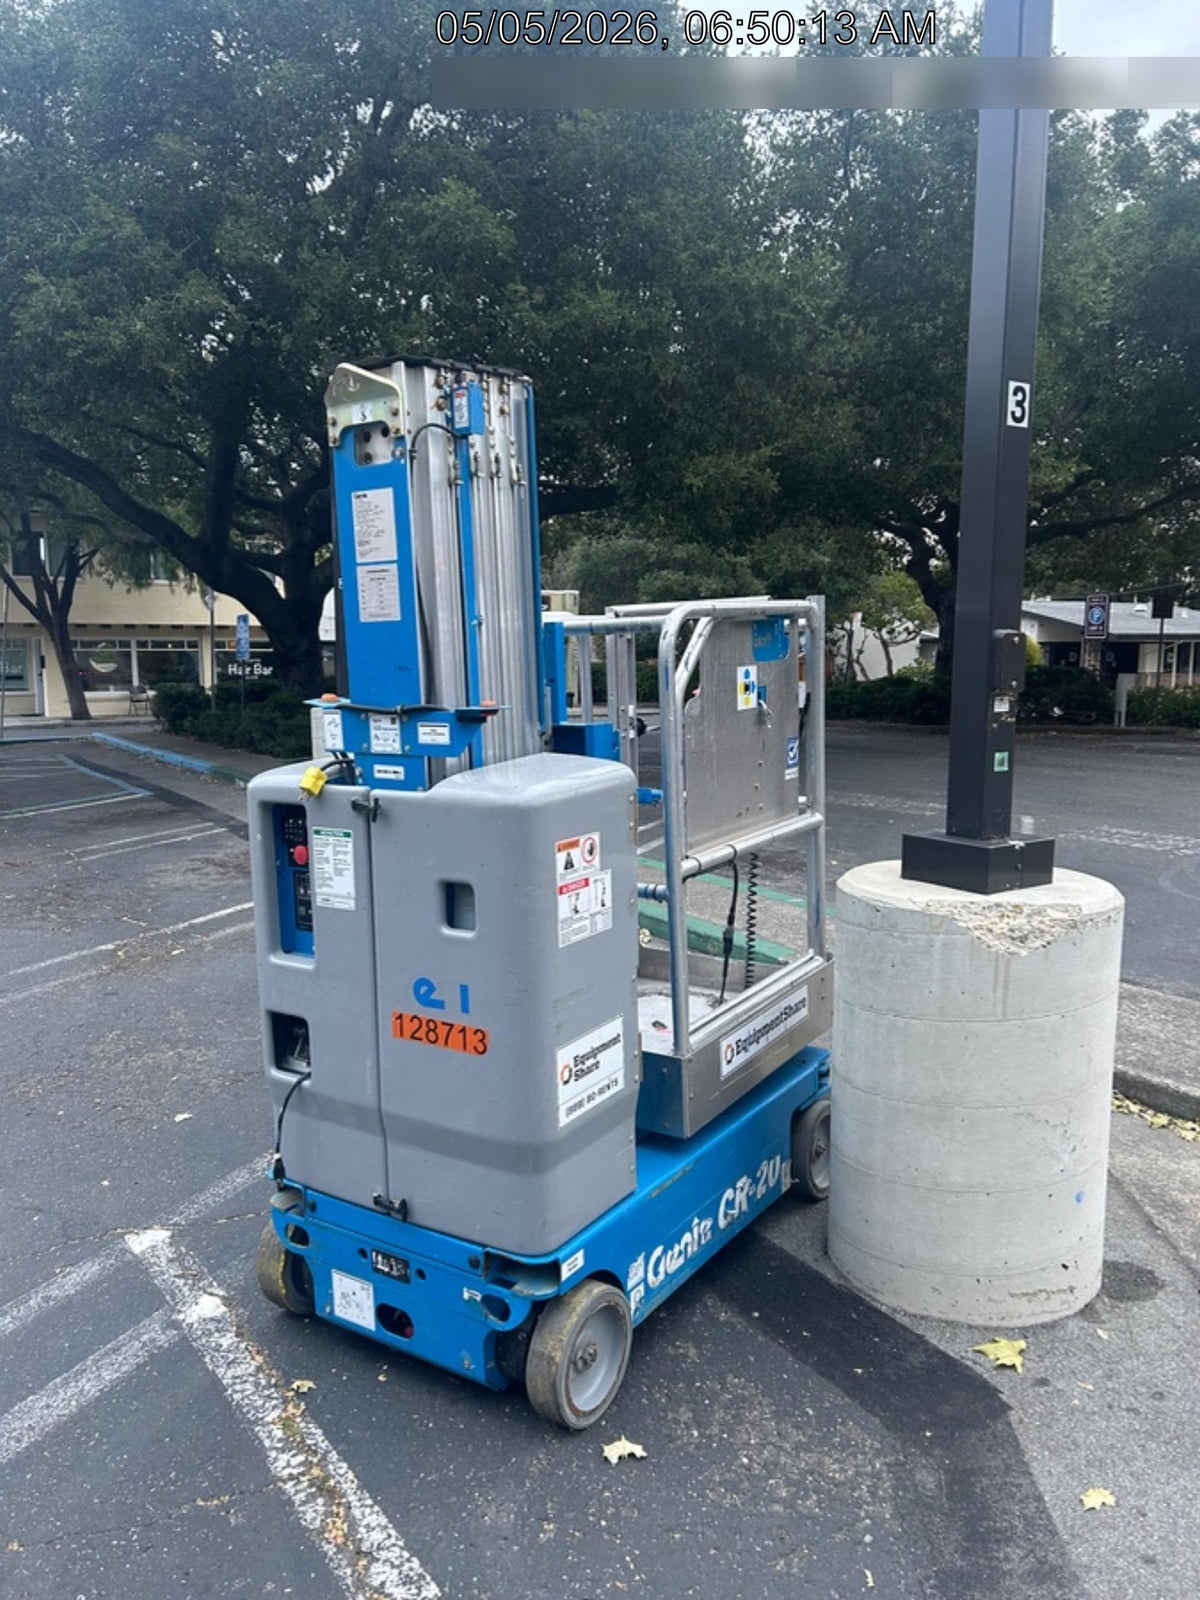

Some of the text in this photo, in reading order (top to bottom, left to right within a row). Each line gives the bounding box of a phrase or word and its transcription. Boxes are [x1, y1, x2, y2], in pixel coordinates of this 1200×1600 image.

[1011, 385, 1027, 424] 3
[253, 663, 273, 676] Bar
[394, 1012, 487, 1055] 128713
[735, 996, 807, 1056] EquipmentShare
[573, 1033, 621, 1068] Equipment
[573, 1060, 600, 1082] Share
